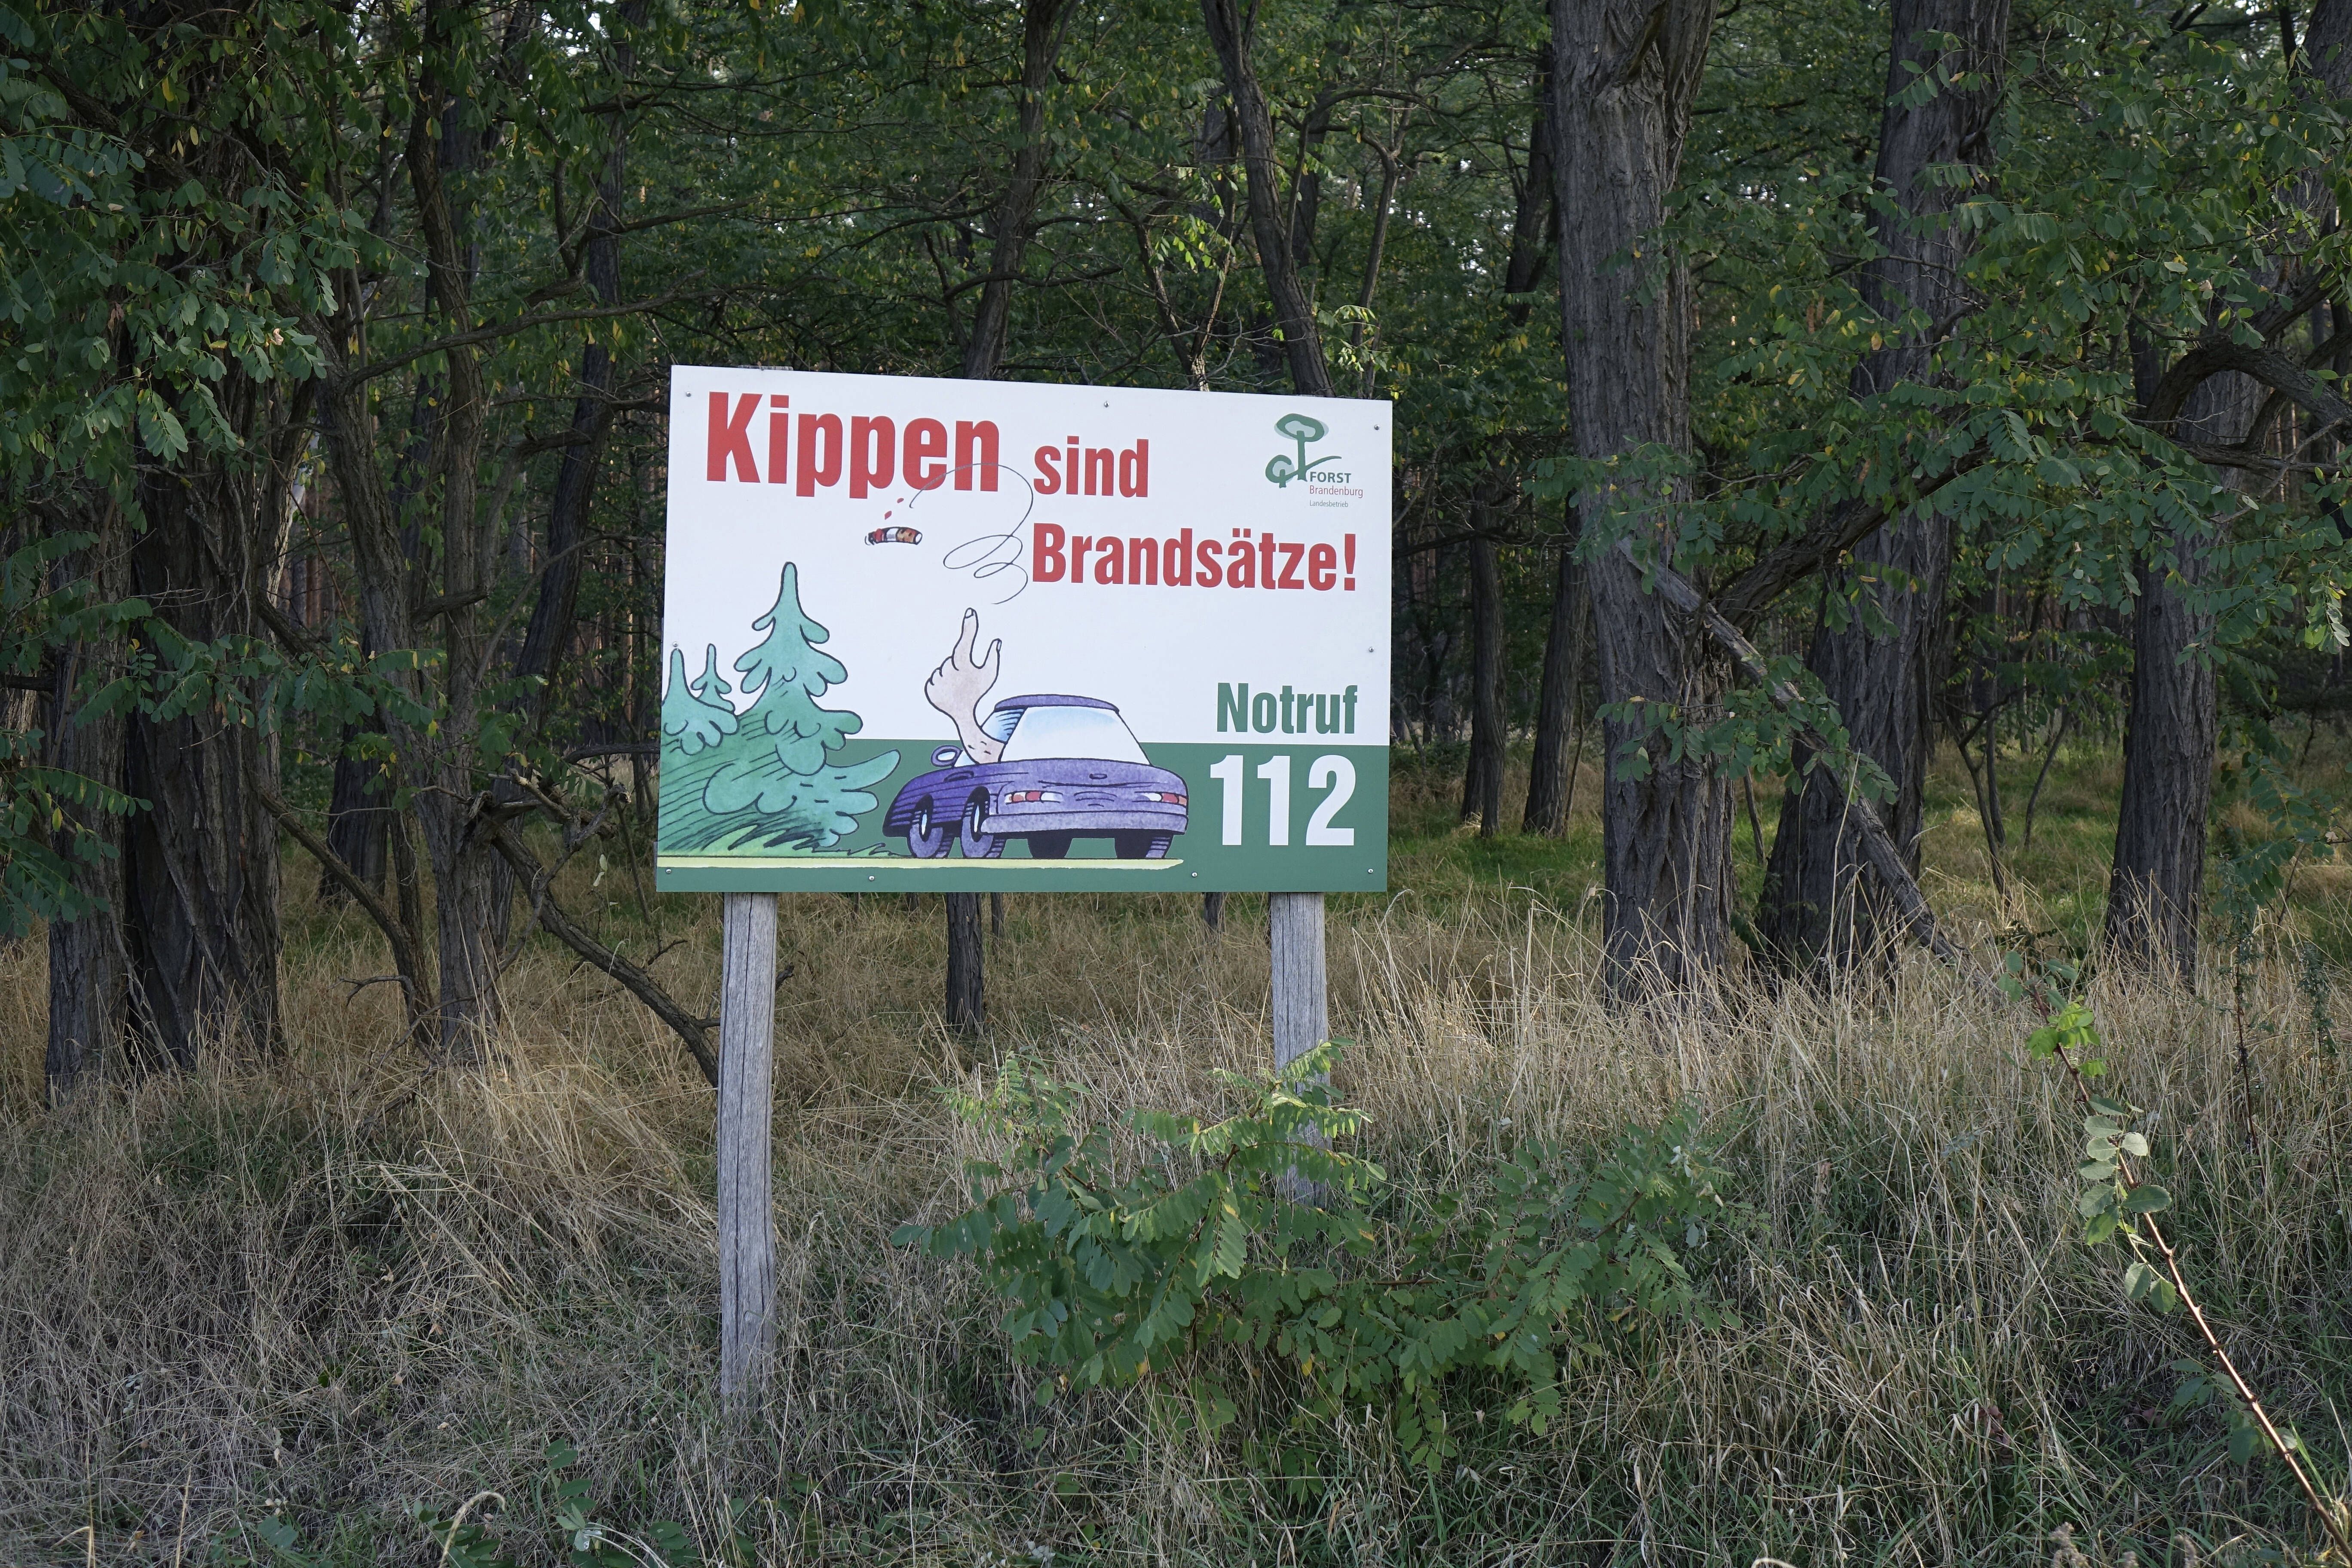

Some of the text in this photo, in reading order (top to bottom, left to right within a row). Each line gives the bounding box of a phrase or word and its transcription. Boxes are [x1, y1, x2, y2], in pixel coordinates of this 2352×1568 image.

[707, 392, 1148, 499] Kippen sind
[1309, 485, 1363, 499] Brandenburg
[1310, 471, 1352, 484] FORST
[1032, 523, 1357, 591] Brandsätze!
[1217, 683, 1357, 734] Notruf
[1210, 754, 1356, 846] 112
